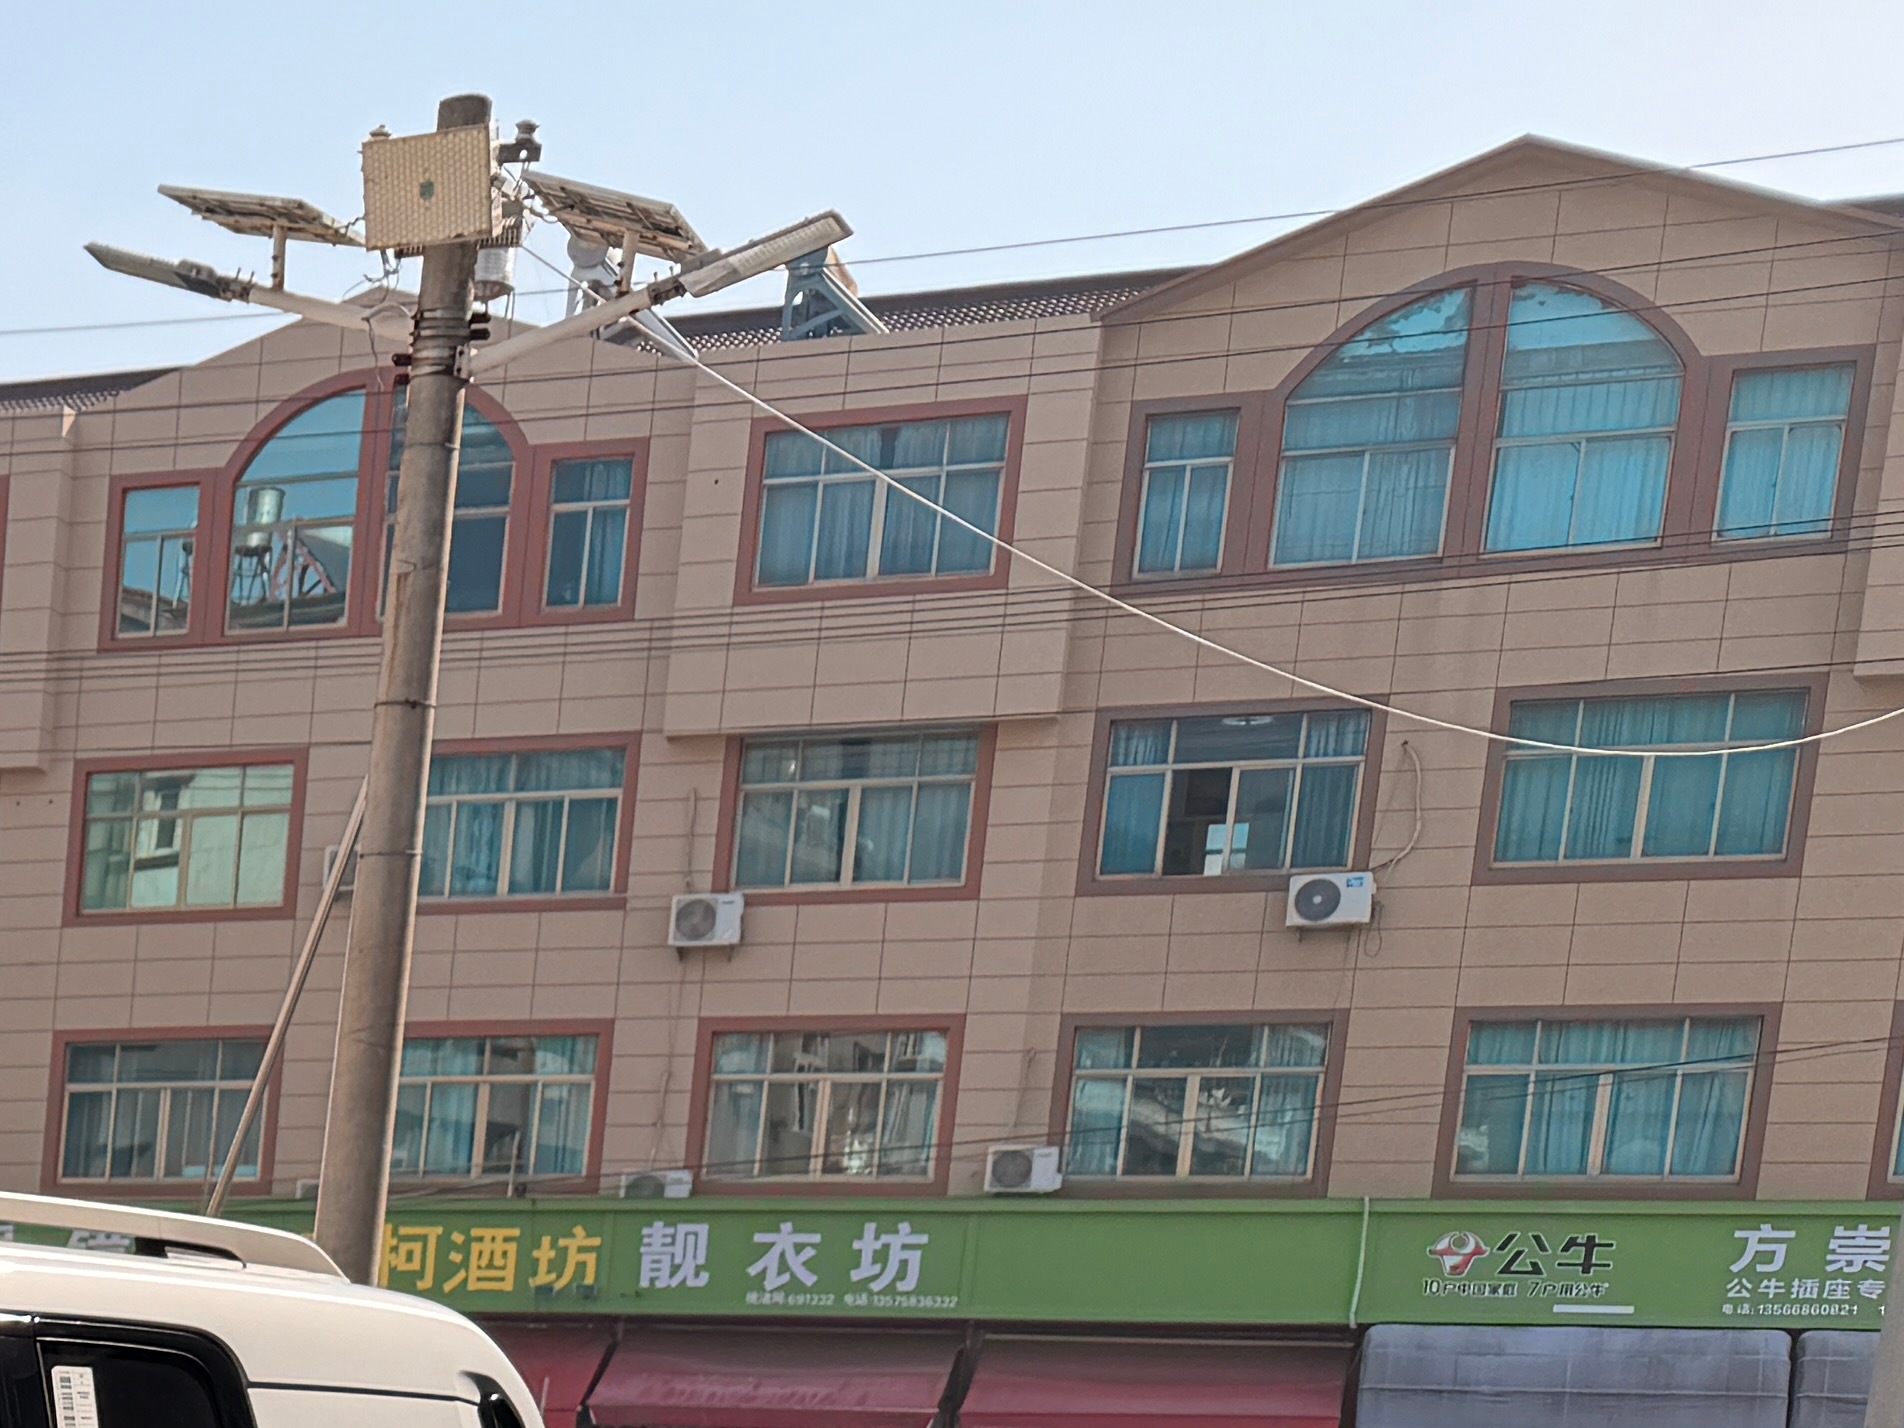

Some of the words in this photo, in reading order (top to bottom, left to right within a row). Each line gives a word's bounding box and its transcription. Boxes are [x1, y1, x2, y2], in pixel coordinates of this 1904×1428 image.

[638, 1220, 930, 1293] 靓衣坊
[1493, 1231, 1616, 1277] 公牛
[1728, 1223, 1892, 1273] 方崇
[1725, 1277, 1887, 1300] 公牛插座专
